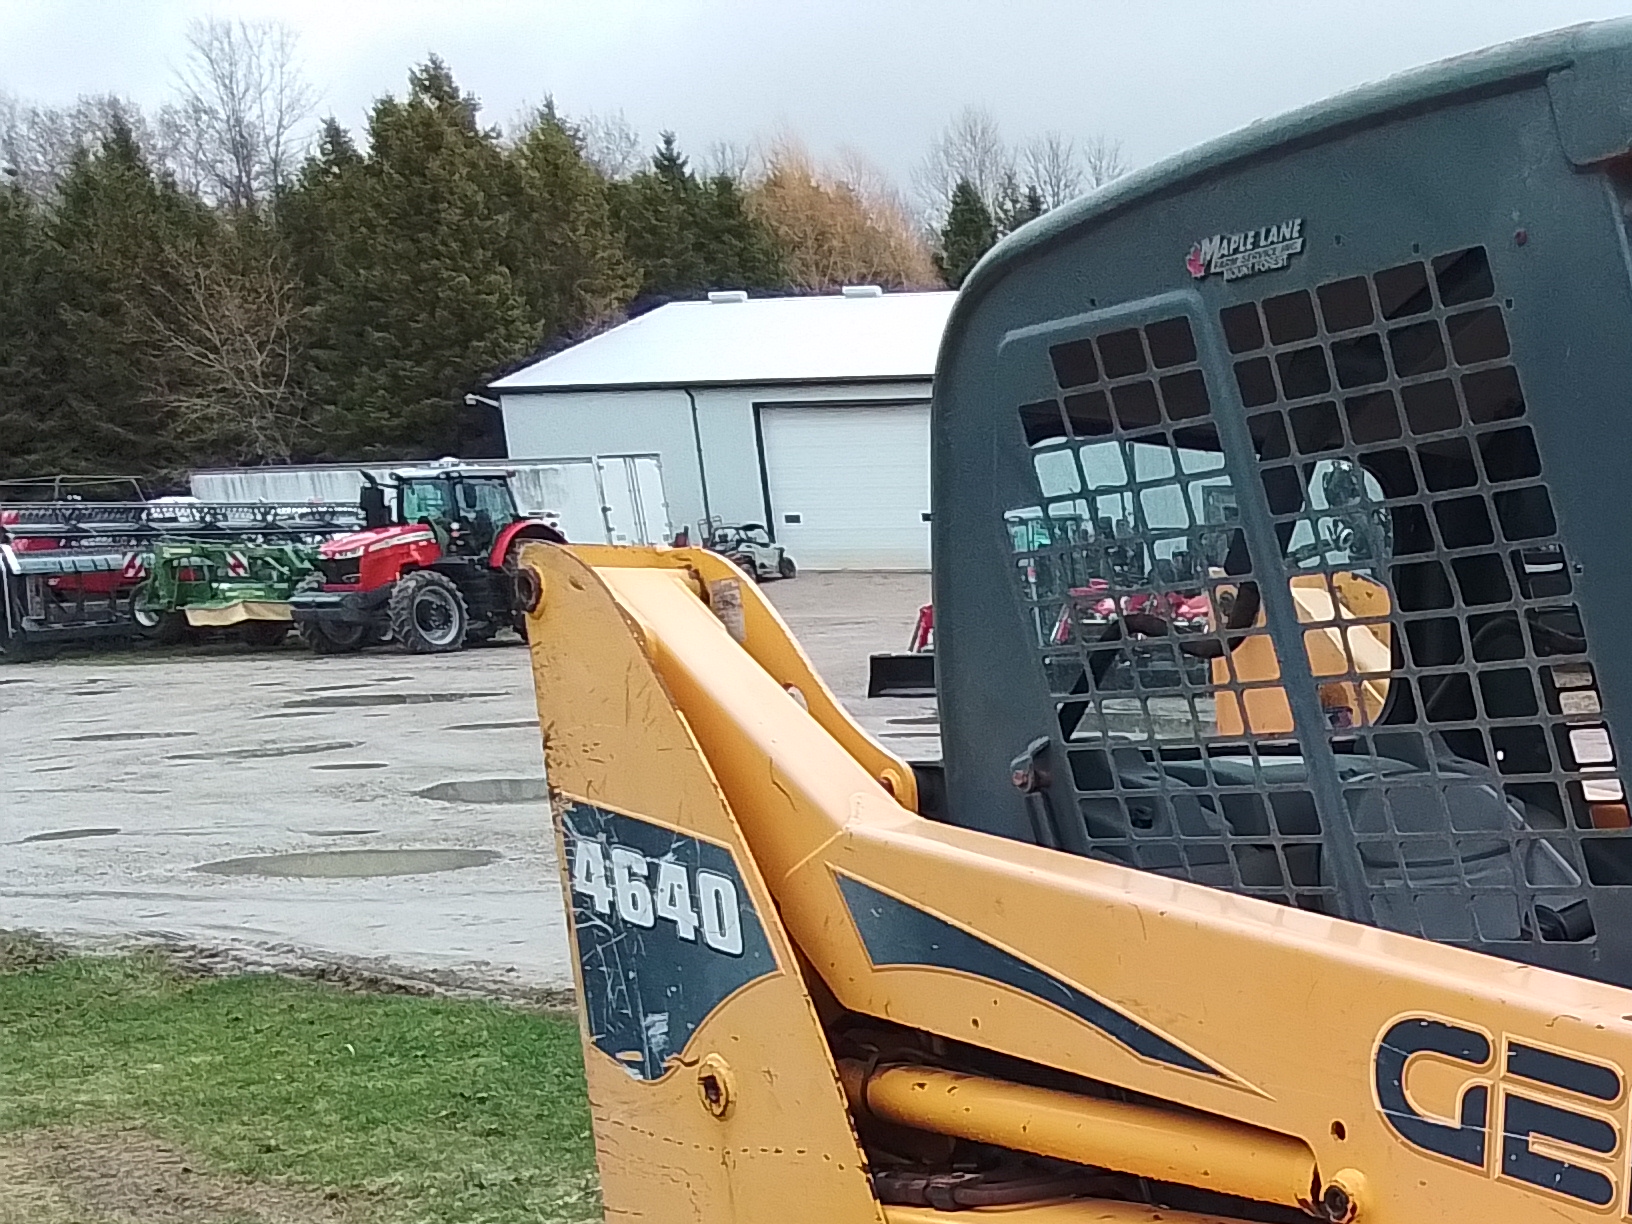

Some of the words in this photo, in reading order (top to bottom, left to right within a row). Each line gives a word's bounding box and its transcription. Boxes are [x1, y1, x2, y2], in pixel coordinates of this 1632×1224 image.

[1200, 231, 1255, 269] MAPLE
[1259, 218, 1302, 247] LANE
[573, 838, 745, 958] 4640
